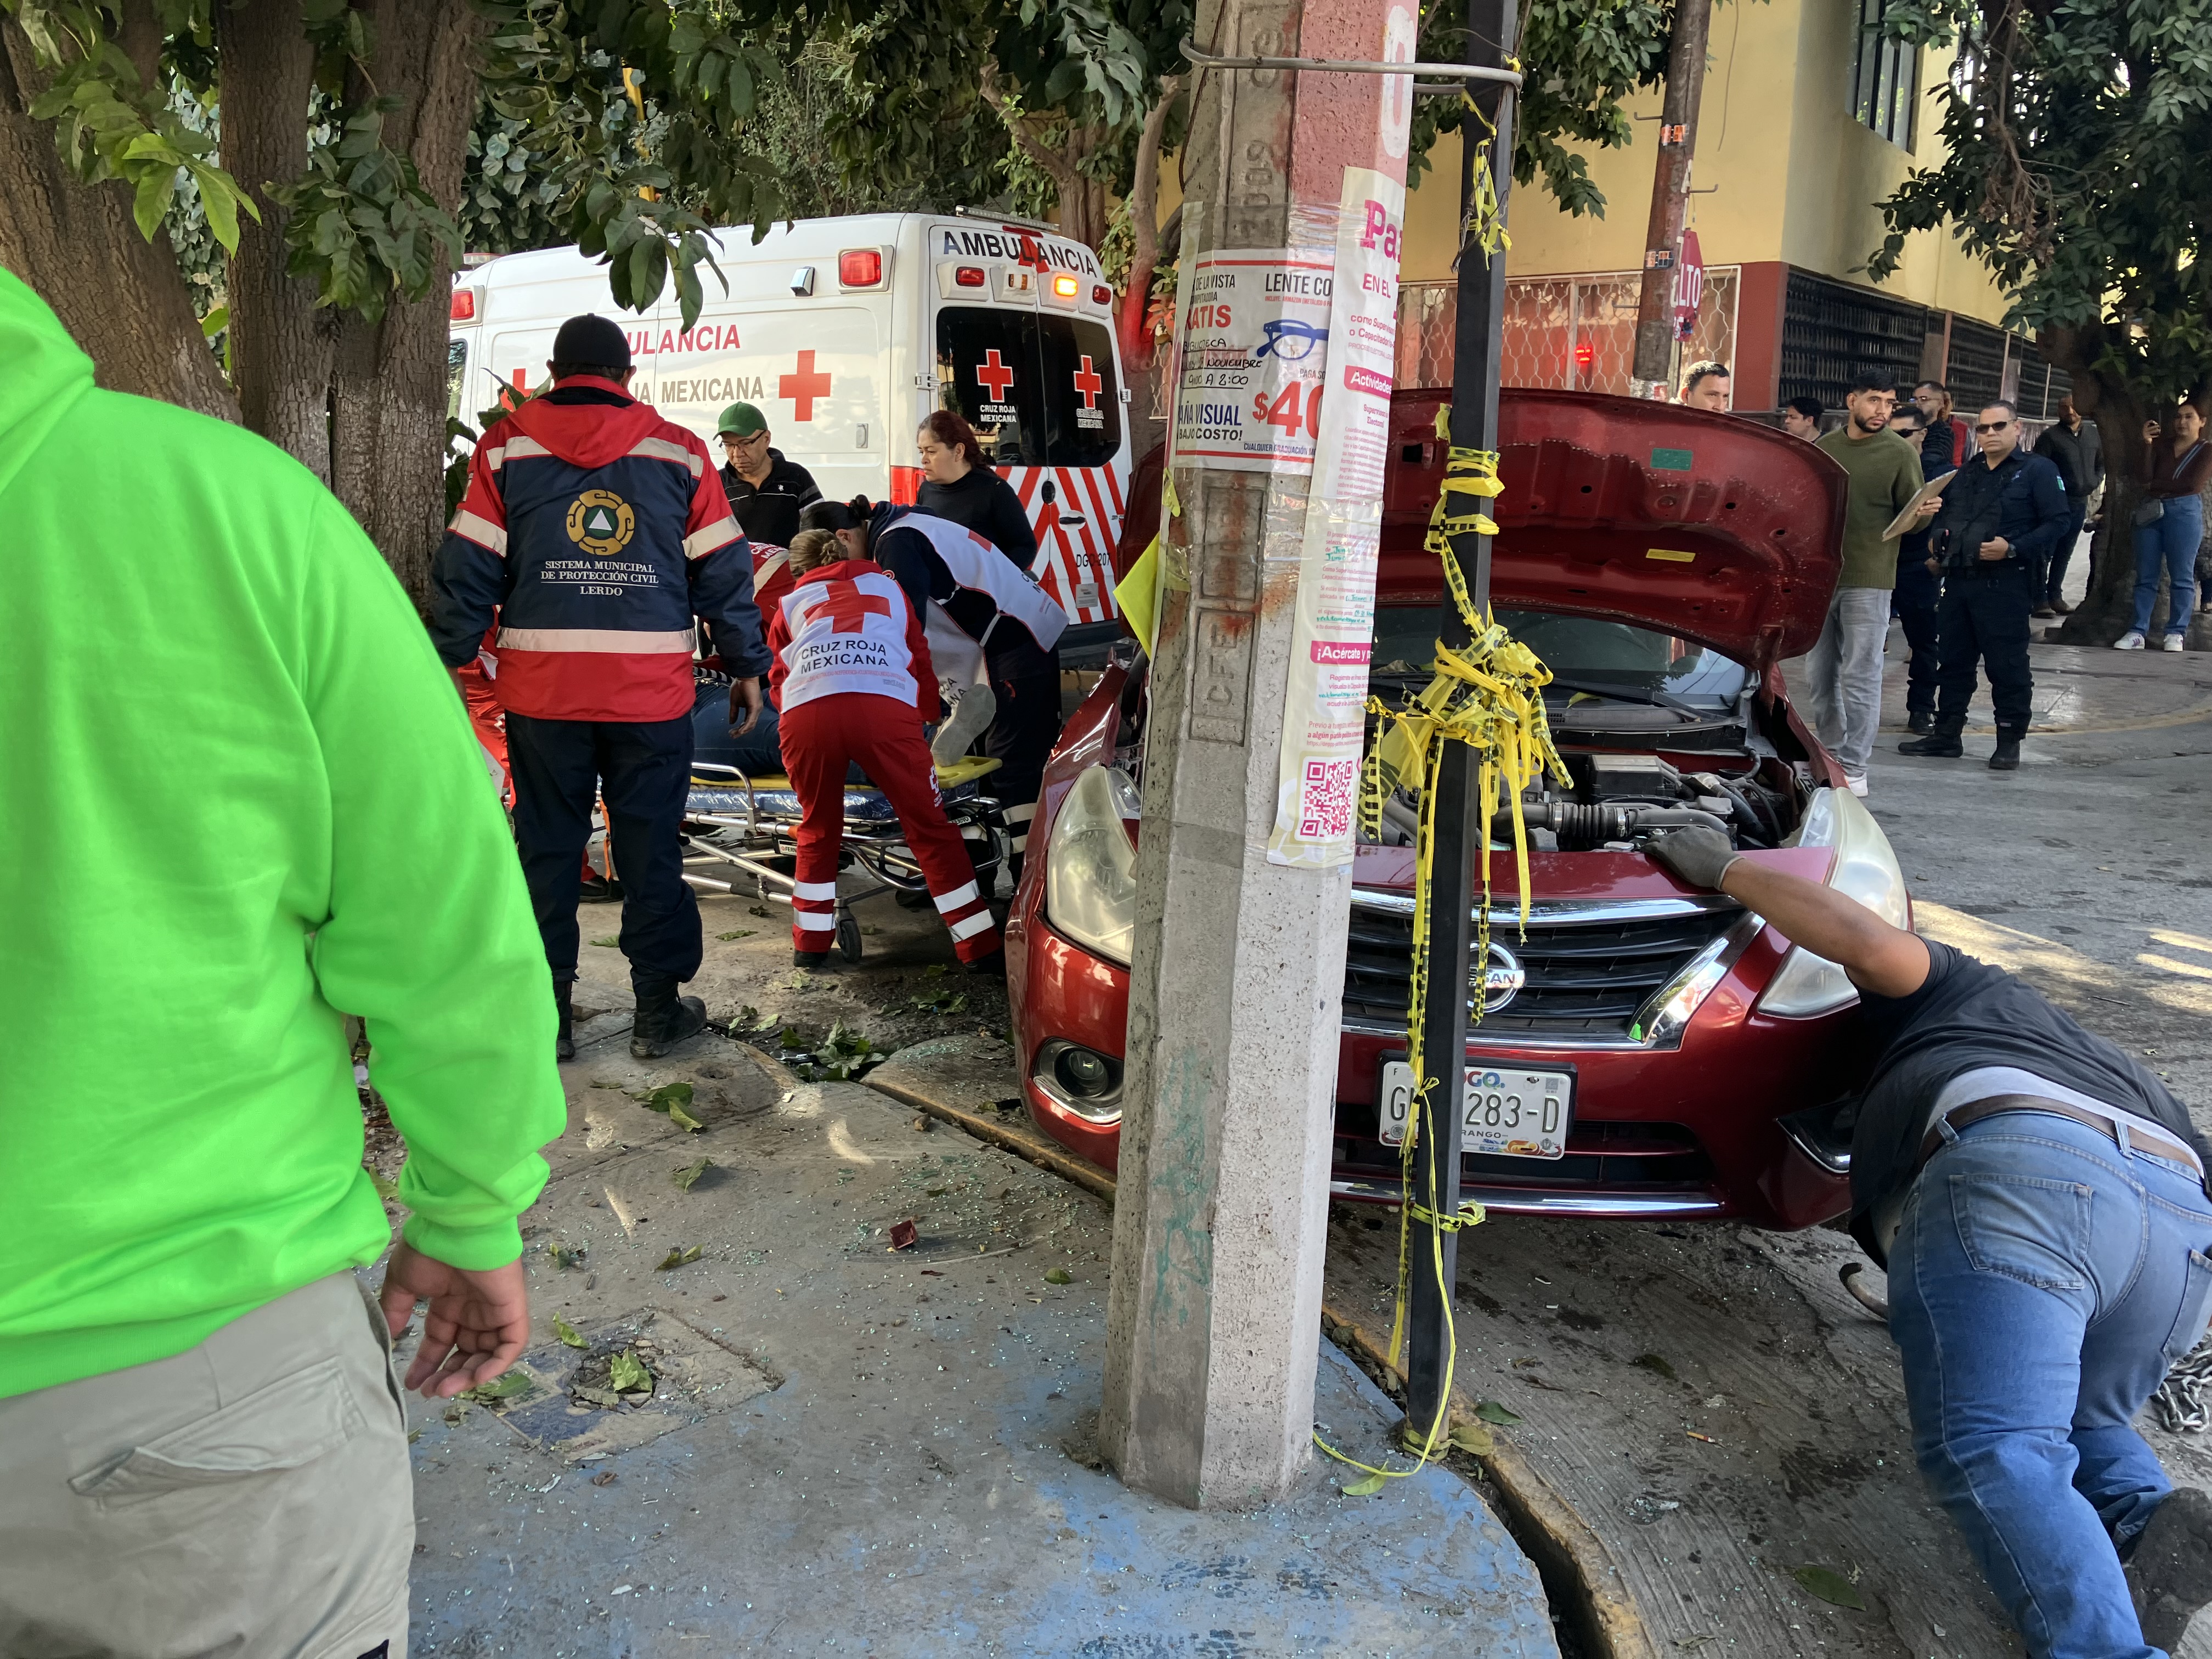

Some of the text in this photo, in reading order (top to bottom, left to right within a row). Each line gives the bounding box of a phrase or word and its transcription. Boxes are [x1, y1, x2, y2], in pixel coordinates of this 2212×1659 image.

[944, 232, 1097, 278] AMBULANCIA
[1195, 276, 1202, 290] DE
[1211, 274, 1235, 289] VISTA
[1266, 273, 1310, 295] LENTE
[1363, 273, 1391, 298] EN EL
[1678, 263, 1701, 308] LTO
[1191, 291, 1217, 304] MPUTADORA
[1351, 315, 1372, 325] como
[627, 325, 740, 356] ULANCIA
[1183, 338, 1227, 352] BIBLIOTECA
[1207, 358, 1262, 369] NOVIEMBRE
[1205, 374, 1213, 386] A
[1218, 374, 1249, 386] 2:00
[1300, 368, 1316, 379] PAGA
[1350, 370, 1392, 395] Actividades
[662, 376, 764, 403] MEXICANA
[980, 404, 1016, 414] CRUZ ROJA
[1196, 403, 1242, 426] VISUAL
[980, 414, 1017, 422] MEXICANA
[1179, 428, 1243, 441] BAJO COSTO!
[1244, 443, 1273, 453] CUALQUIER
[1273, 443, 1308, 455] GRADUACIÓN
[545, 560, 655, 573] SISTEMA MUNICIPAL
[540, 571, 659, 584] DE PROTECCIÓN CIVIL
[580, 586, 623, 596] LERDO
[802, 640, 887, 659] CRUZ ROJA
[1317, 645, 1361, 661] ¡Acércate
[1362, 650, 1365, 662] y
[801, 653, 889, 674] MEXICANA
[939, 678, 957, 695] OJA
[1308, 720, 1327, 729] Previo
[1312, 731, 1329, 740] algún
[1393, 1068, 1398, 1076] F
[1462, 1130, 1502, 1138] RANGO
